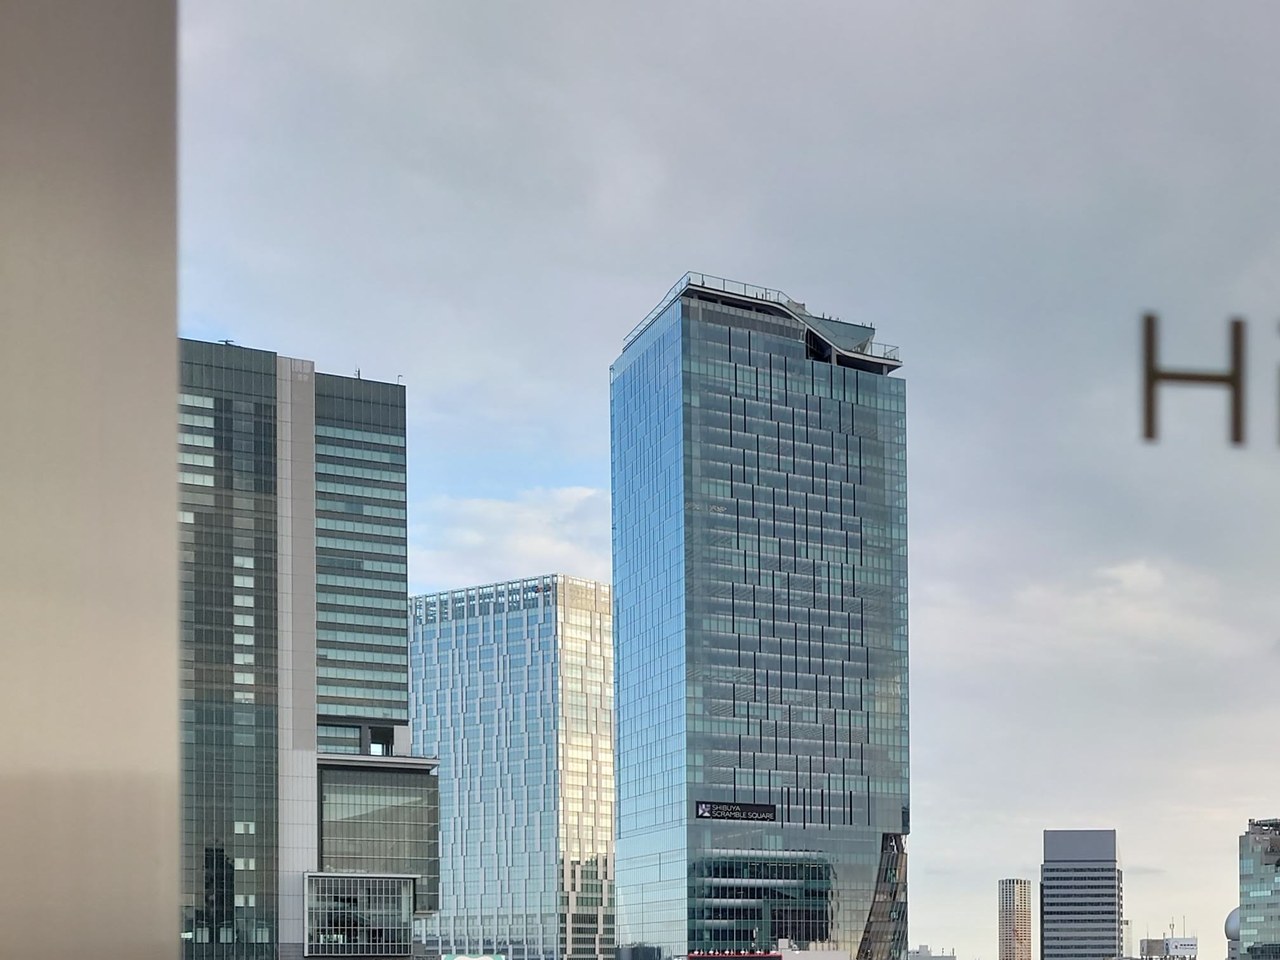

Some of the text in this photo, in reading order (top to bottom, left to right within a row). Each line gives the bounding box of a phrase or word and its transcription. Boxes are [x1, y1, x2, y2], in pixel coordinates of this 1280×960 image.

[712, 804, 741, 812] SHIBUYA
[712, 810, 774, 820] SCRAMBLE SQUARE
